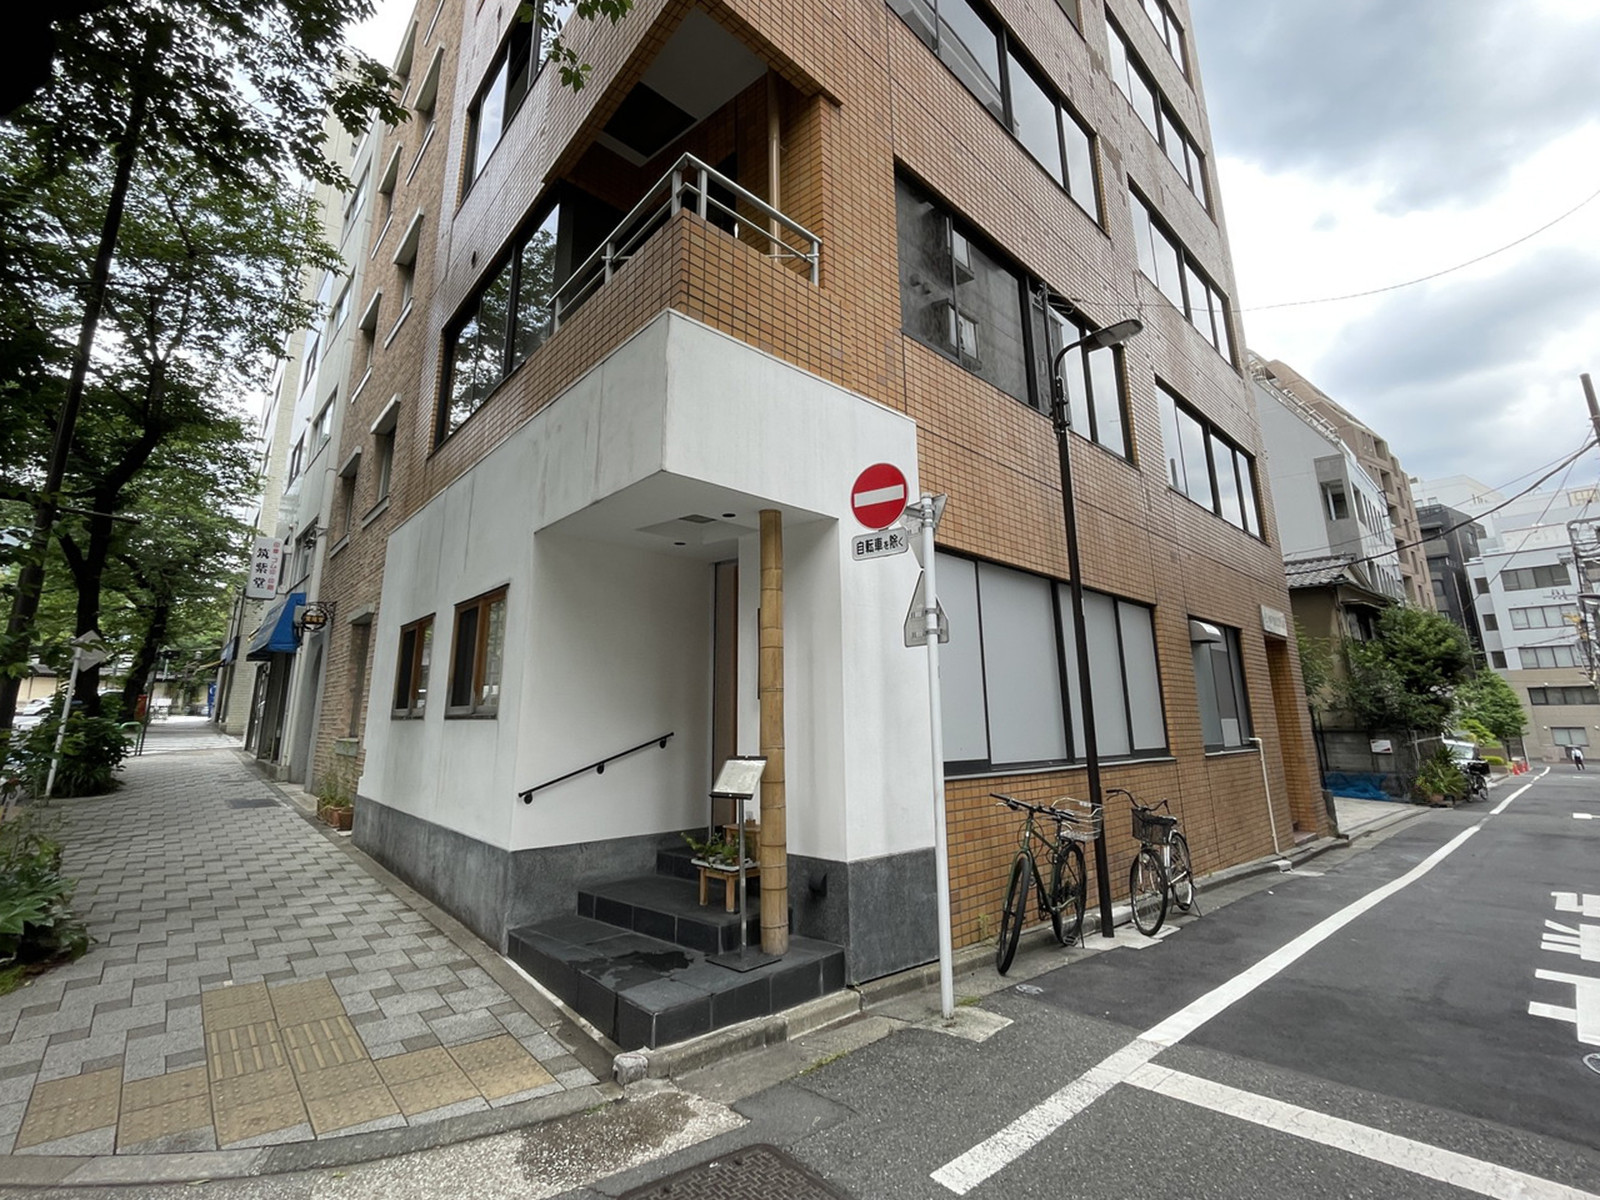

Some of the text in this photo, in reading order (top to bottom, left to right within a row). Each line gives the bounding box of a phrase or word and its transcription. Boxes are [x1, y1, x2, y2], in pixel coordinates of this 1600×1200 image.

[856, 534, 903, 555] 自転車を除く
[253, 547, 269, 589] 筑紫堂
